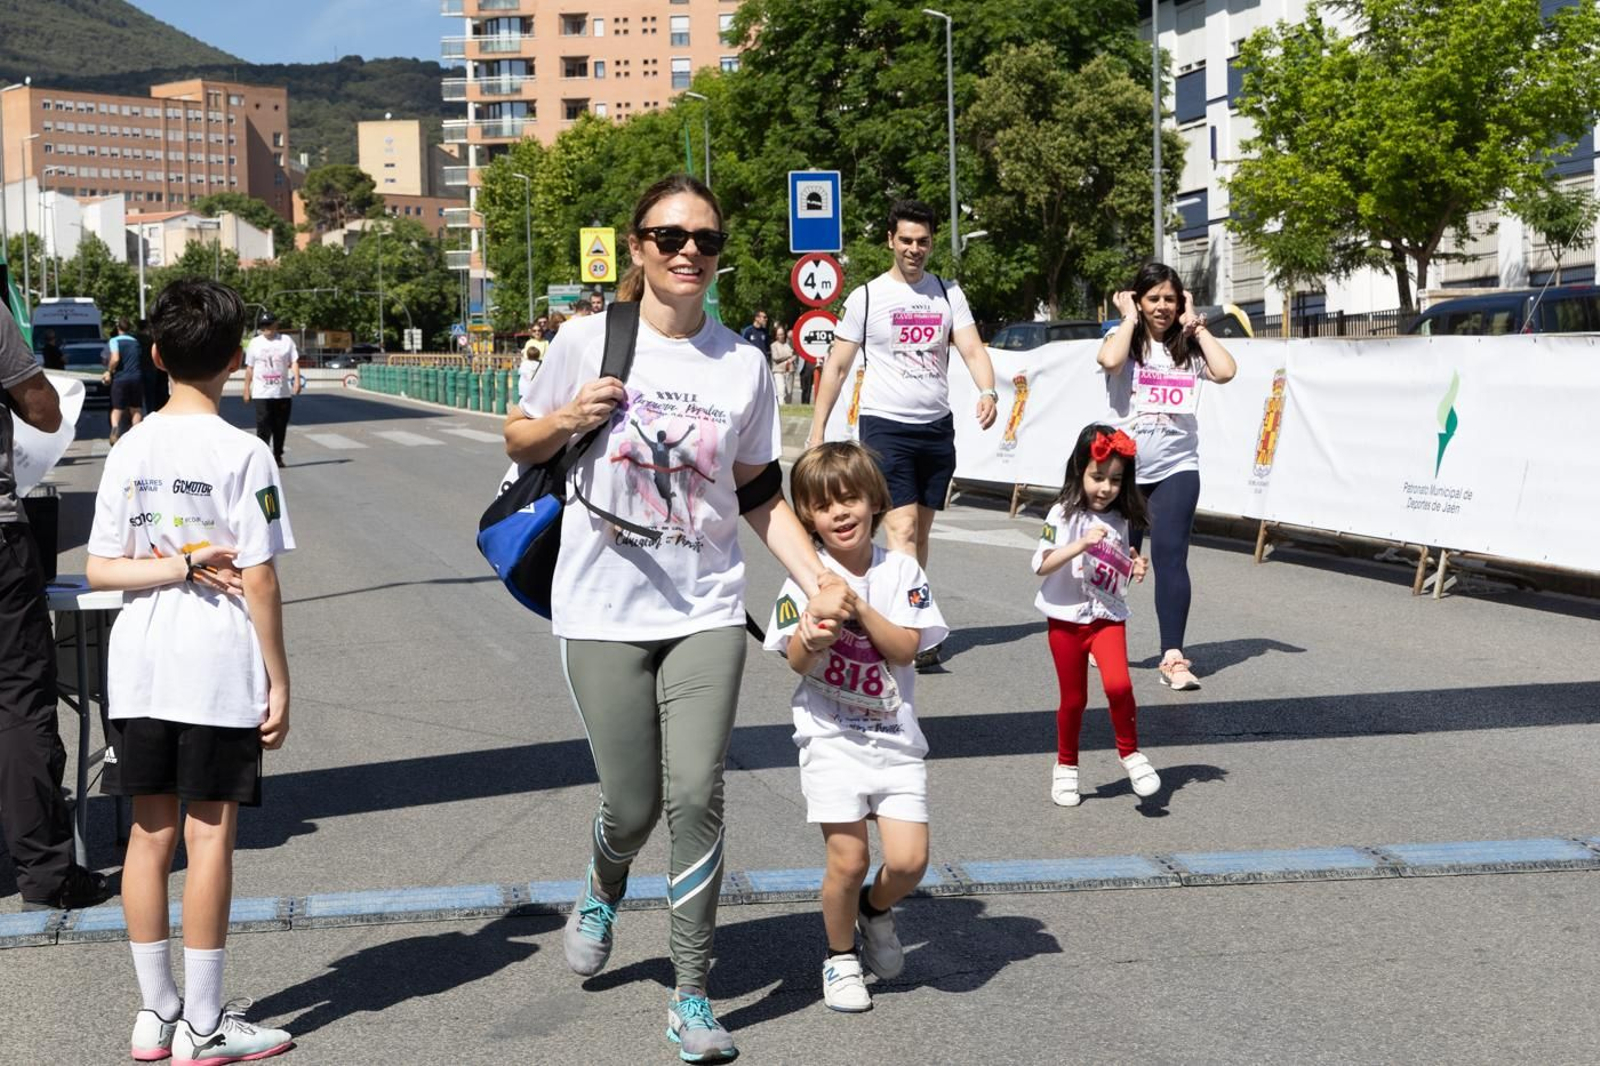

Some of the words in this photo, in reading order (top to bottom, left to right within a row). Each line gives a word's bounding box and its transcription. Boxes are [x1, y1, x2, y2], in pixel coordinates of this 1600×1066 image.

[592, 264, 605, 272] 20
[803, 272, 816, 289] 4
[821, 280, 831, 289] m
[816, 332, 827, 340] 10
[899, 327, 935, 343] 509
[656, 391, 697, 402] XXVII
[1148, 387, 1183, 405] 510
[1429, 484, 1463, 500] Municipal
[1463, 487, 1473, 500] de
[1407, 497, 1431, 510] Deportes
[1431, 500, 1441, 512] de
[1091, 563, 1119, 595] 511
[824, 654, 883, 696] 818
